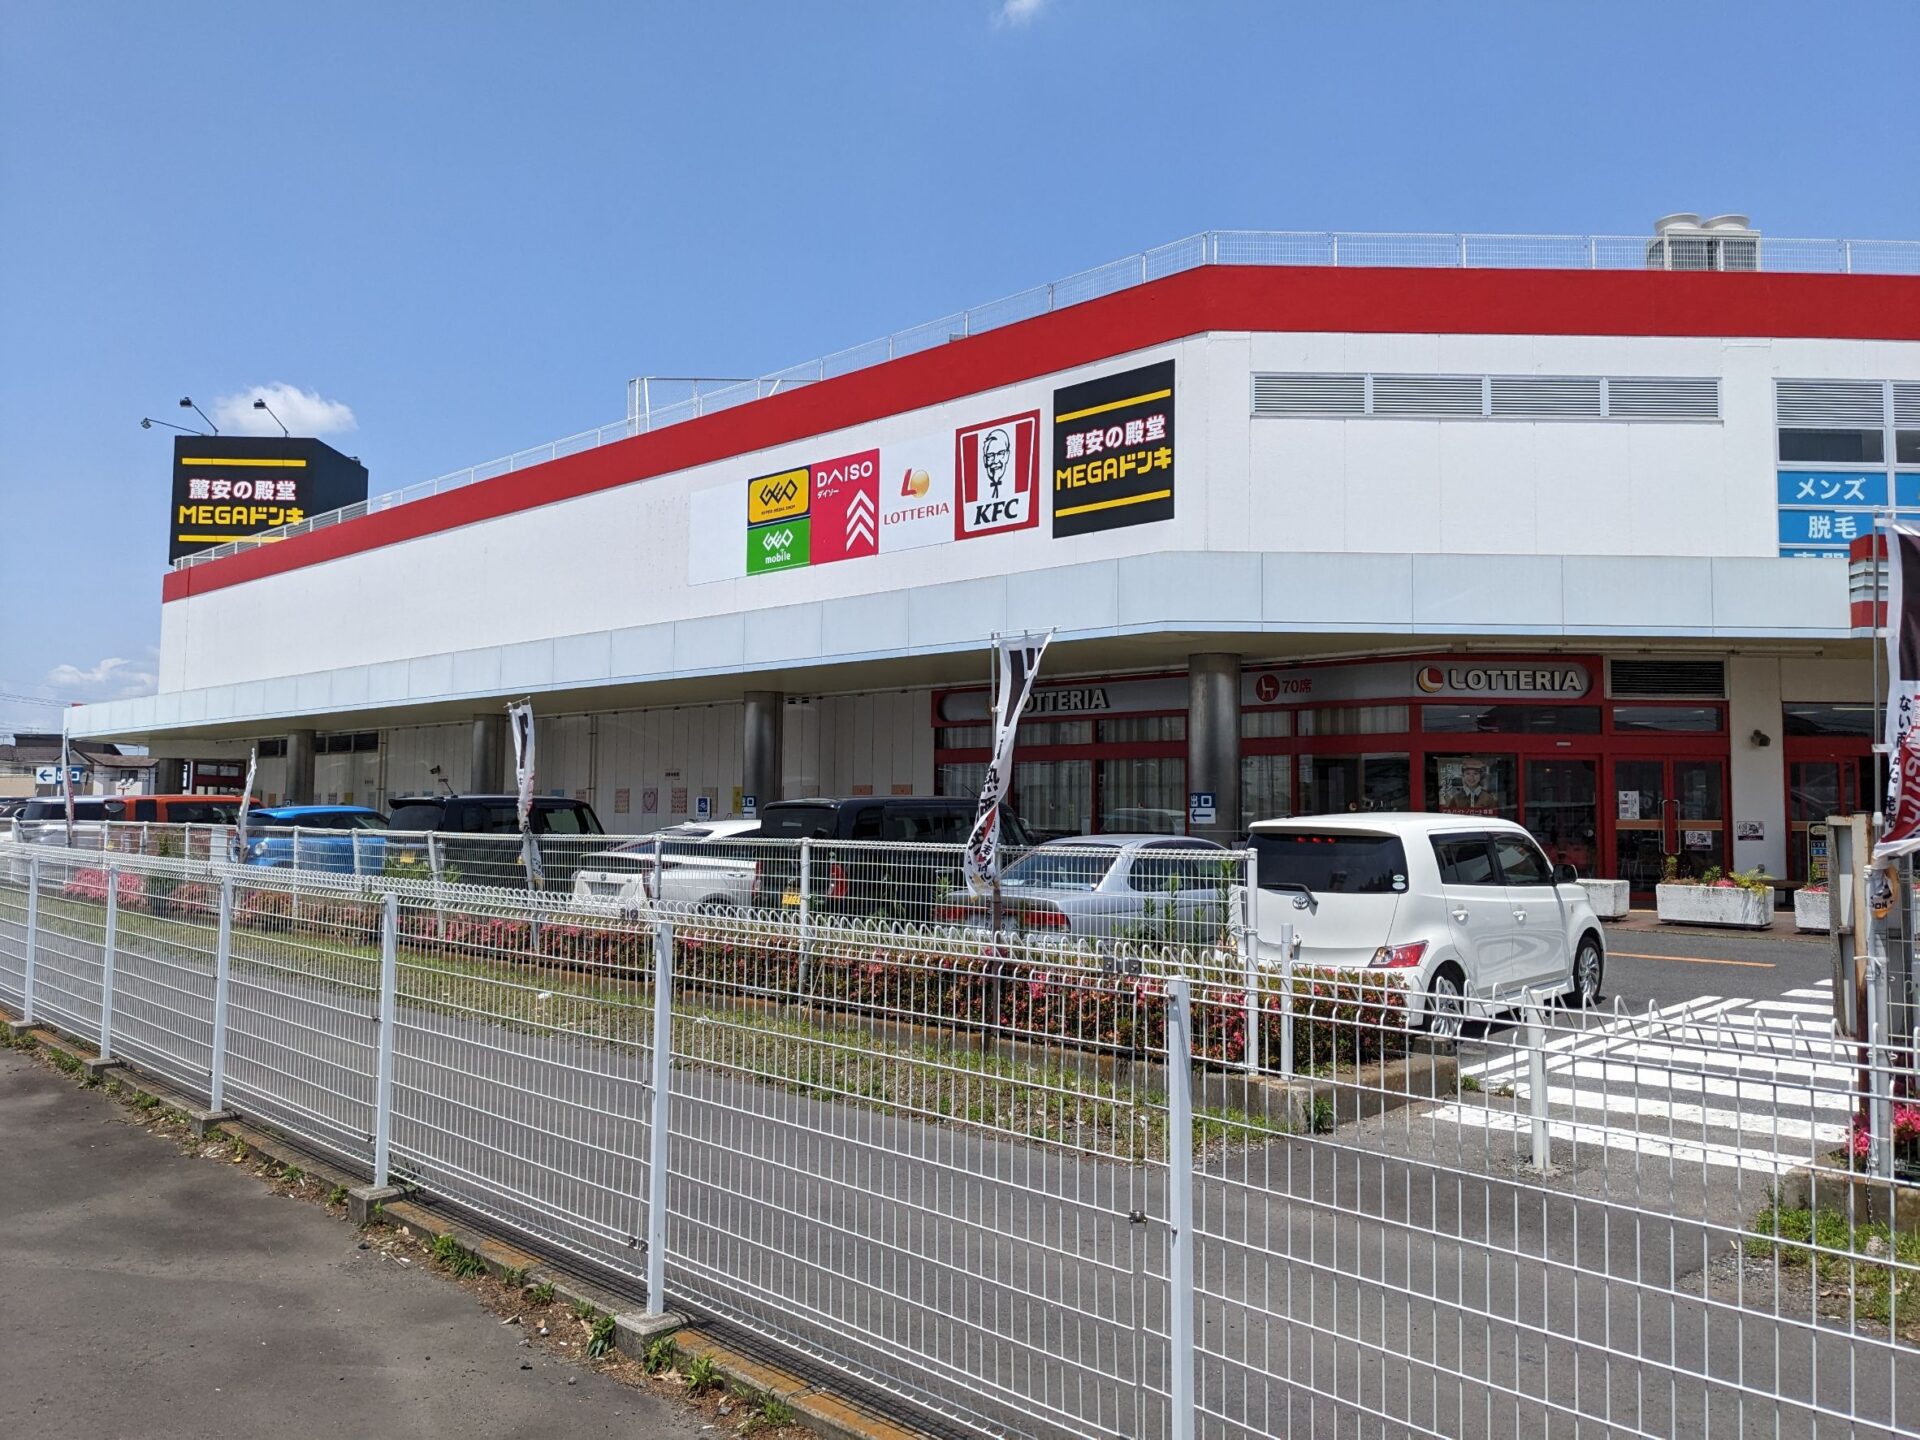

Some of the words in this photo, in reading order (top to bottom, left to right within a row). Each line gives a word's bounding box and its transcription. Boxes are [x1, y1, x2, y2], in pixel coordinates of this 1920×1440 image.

[1065, 414, 1166, 459] 驚安の殿堂
[816, 460, 873, 488] DAISO
[1056, 447, 1172, 491] MEGAドンキ
[188, 479, 297, 501] 驚安の殿堂
[817, 488, 839, 499] ダイソー
[1795, 477, 1866, 501] メンズ
[178, 505, 304, 526] MEGAドンキ
[883, 502, 949, 525] LOTTERIA
[973, 498, 1019, 526] KFC
[1808, 515, 1857, 539] 脱毛
[765, 548, 791, 564] mobile
[1450, 669, 1583, 692] LOTTERIA
